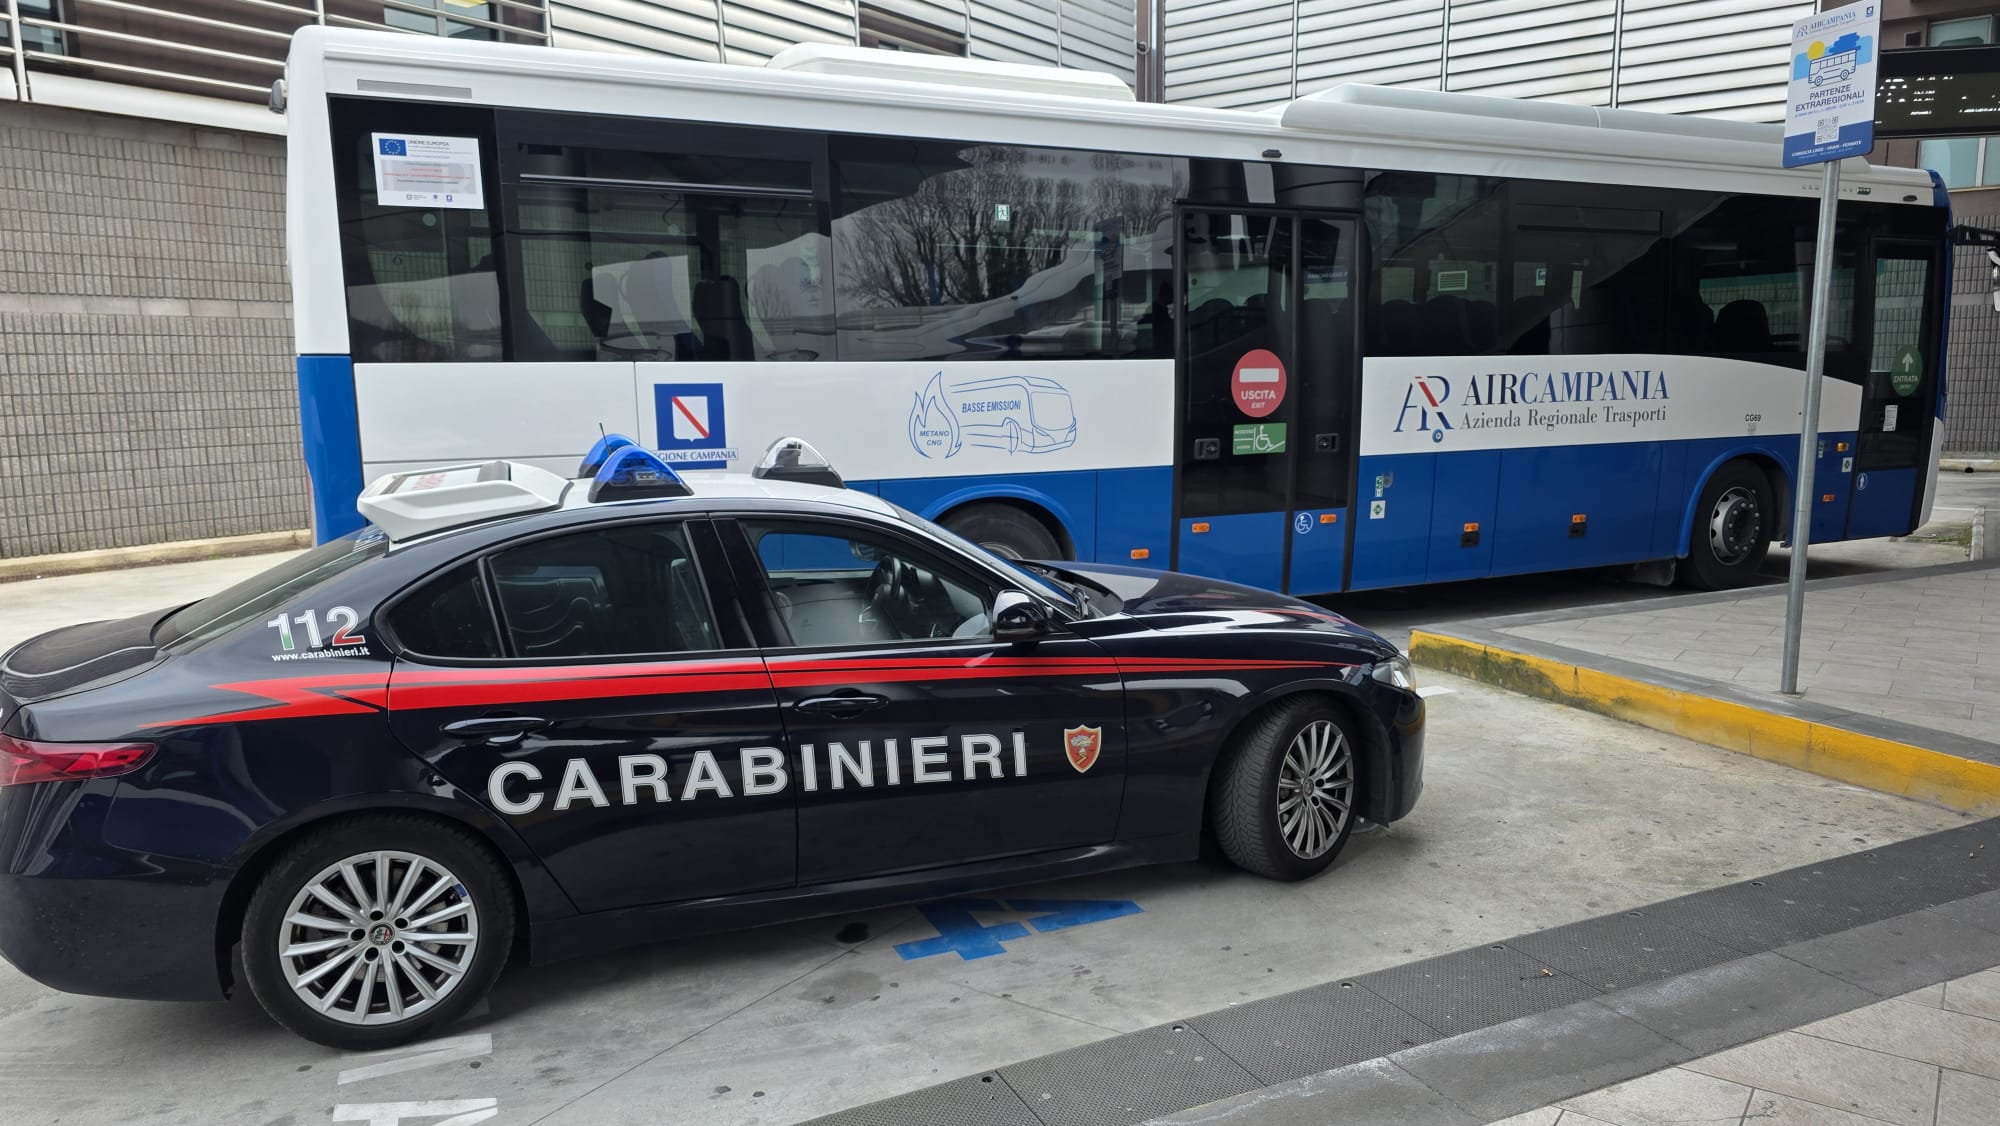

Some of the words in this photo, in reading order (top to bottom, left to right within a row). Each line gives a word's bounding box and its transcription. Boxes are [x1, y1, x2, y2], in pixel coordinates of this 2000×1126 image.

[1809, 84, 1851, 100] PARTENZE
[1795, 90, 1865, 112] EXTRAREGIONALI
[1893, 375, 1918, 384] ENTRATA
[1241, 390, 1276, 400] USCITA
[1461, 370, 1669, 406] AIRCAMPANIA
[961, 402, 985, 413] BASSE
[986, 400, 1021, 411] EMISSIONI
[1460, 409, 1521, 430] Azienda
[1527, 407, 1598, 431] Regionale
[1603, 405, 1667, 427] Trasporti
[653, 452, 688, 461] GIONE
[690, 450, 737, 460] CAMPANIA
[268, 606, 366, 651] 112
[271, 647, 371, 662] www.carabinieri.it
[487, 732, 1029, 815] CARABINIERI
